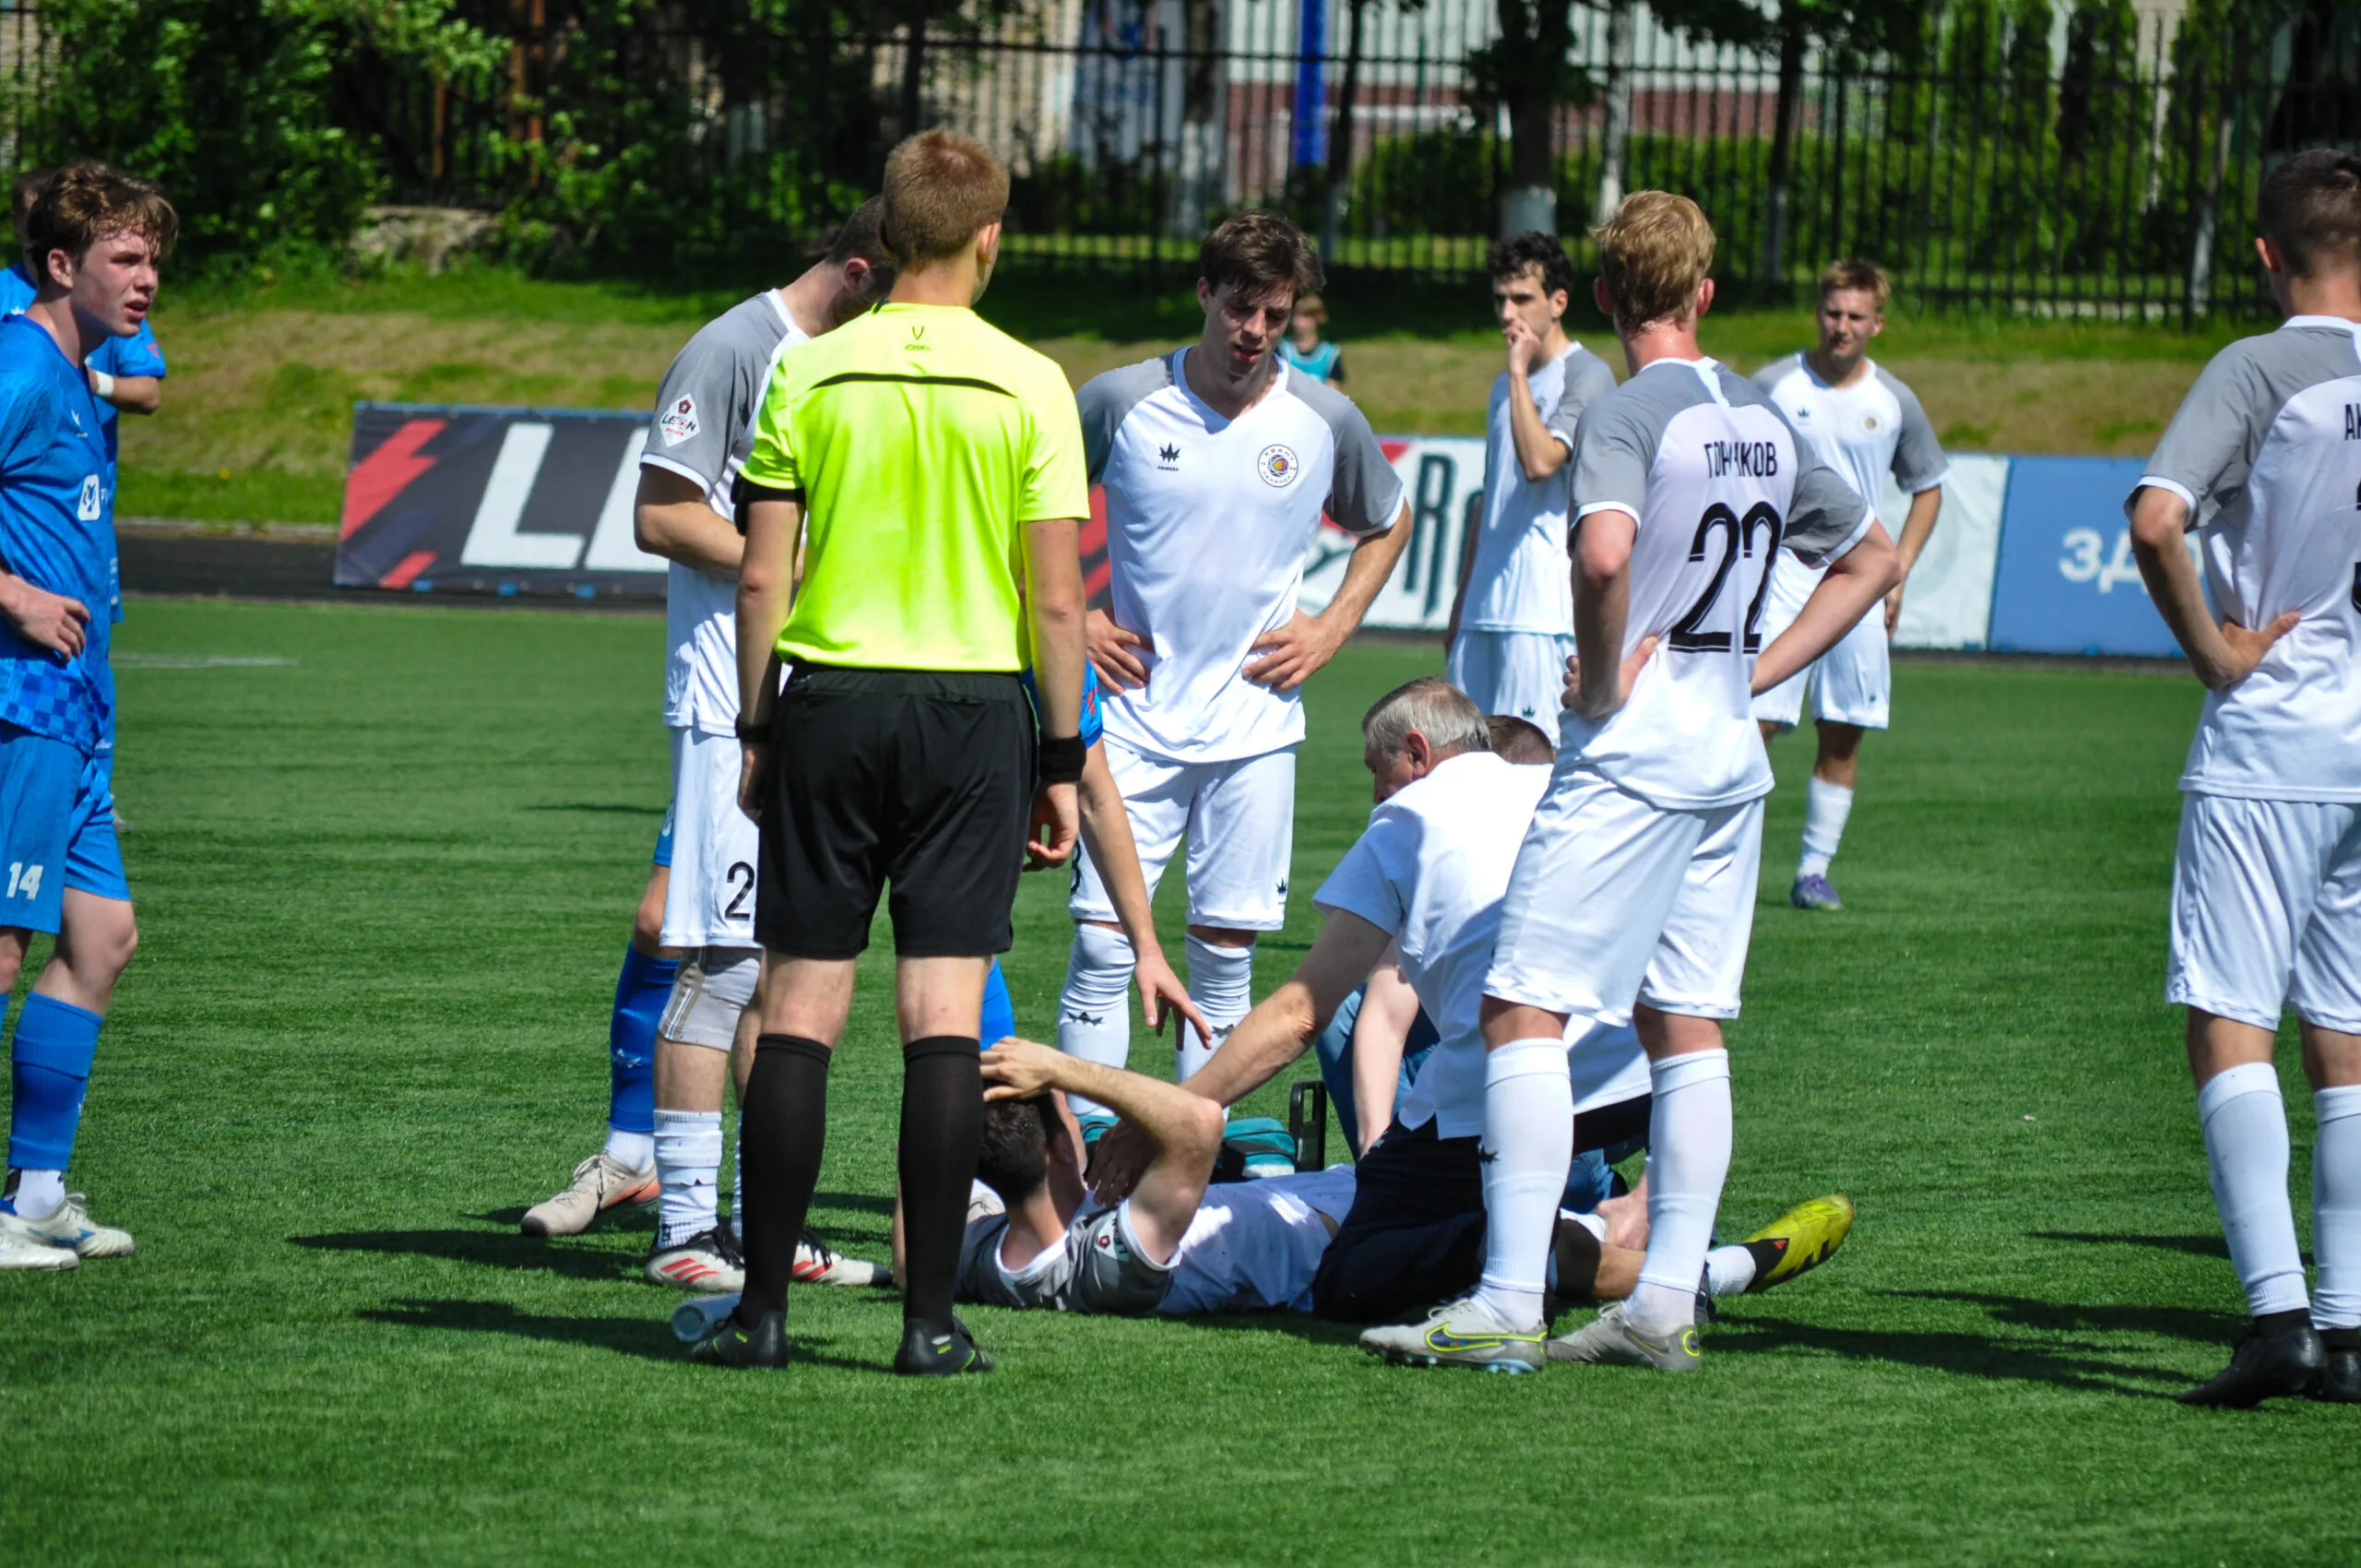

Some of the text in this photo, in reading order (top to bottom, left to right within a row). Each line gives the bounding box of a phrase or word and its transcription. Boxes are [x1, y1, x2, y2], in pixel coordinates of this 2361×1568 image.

[1667, 501, 1782, 654] 22
[6, 861, 44, 901] 14
[724, 861, 755, 921] 2
